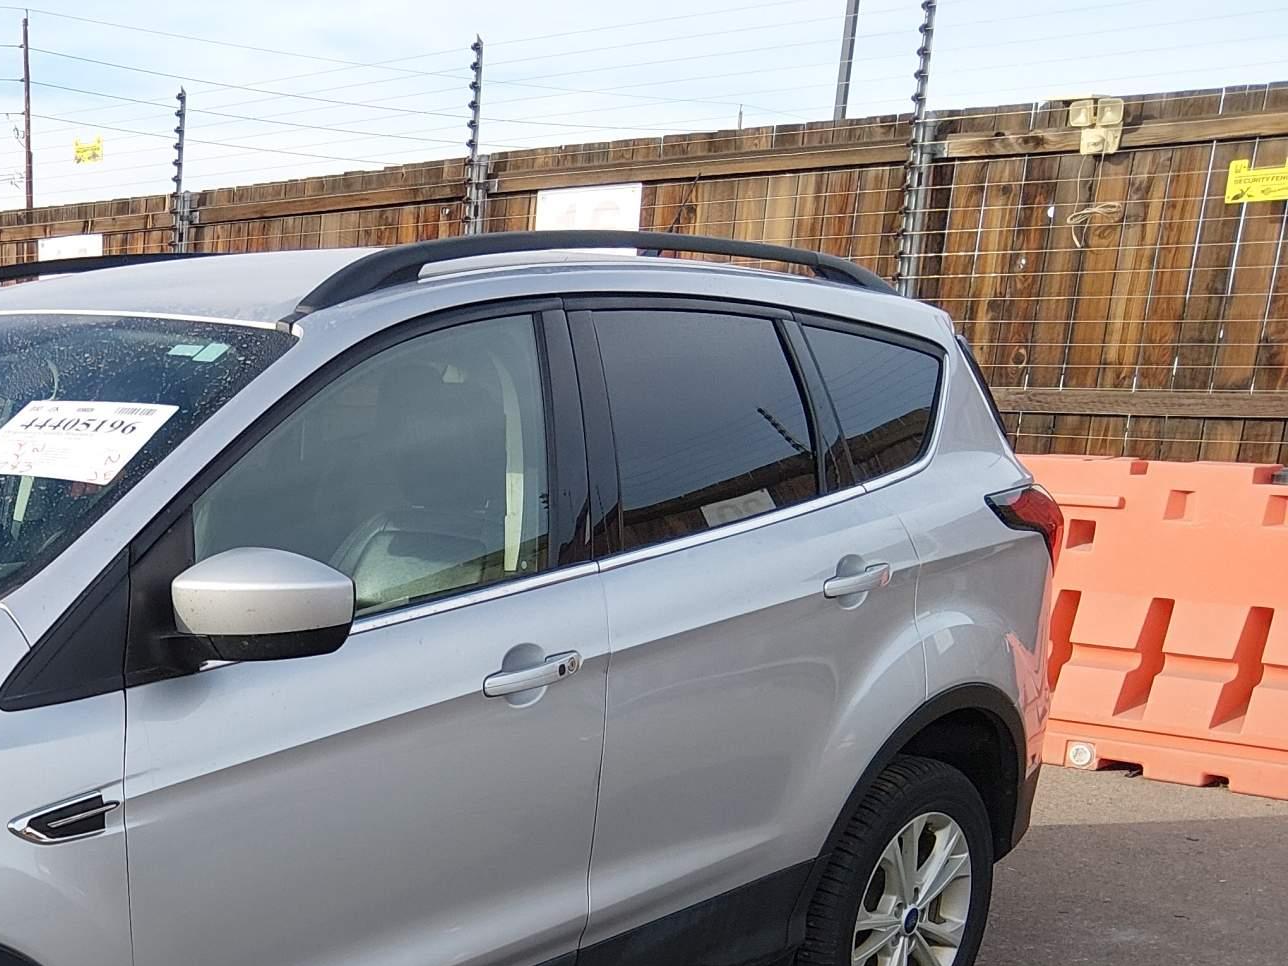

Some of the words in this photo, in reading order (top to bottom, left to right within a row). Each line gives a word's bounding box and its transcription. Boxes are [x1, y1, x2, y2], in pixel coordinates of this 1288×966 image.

[1233, 175, 1270, 185] SECURITY
[1270, 174, 1288, 182] FEN
[20, 417, 142, 435] 44405196
